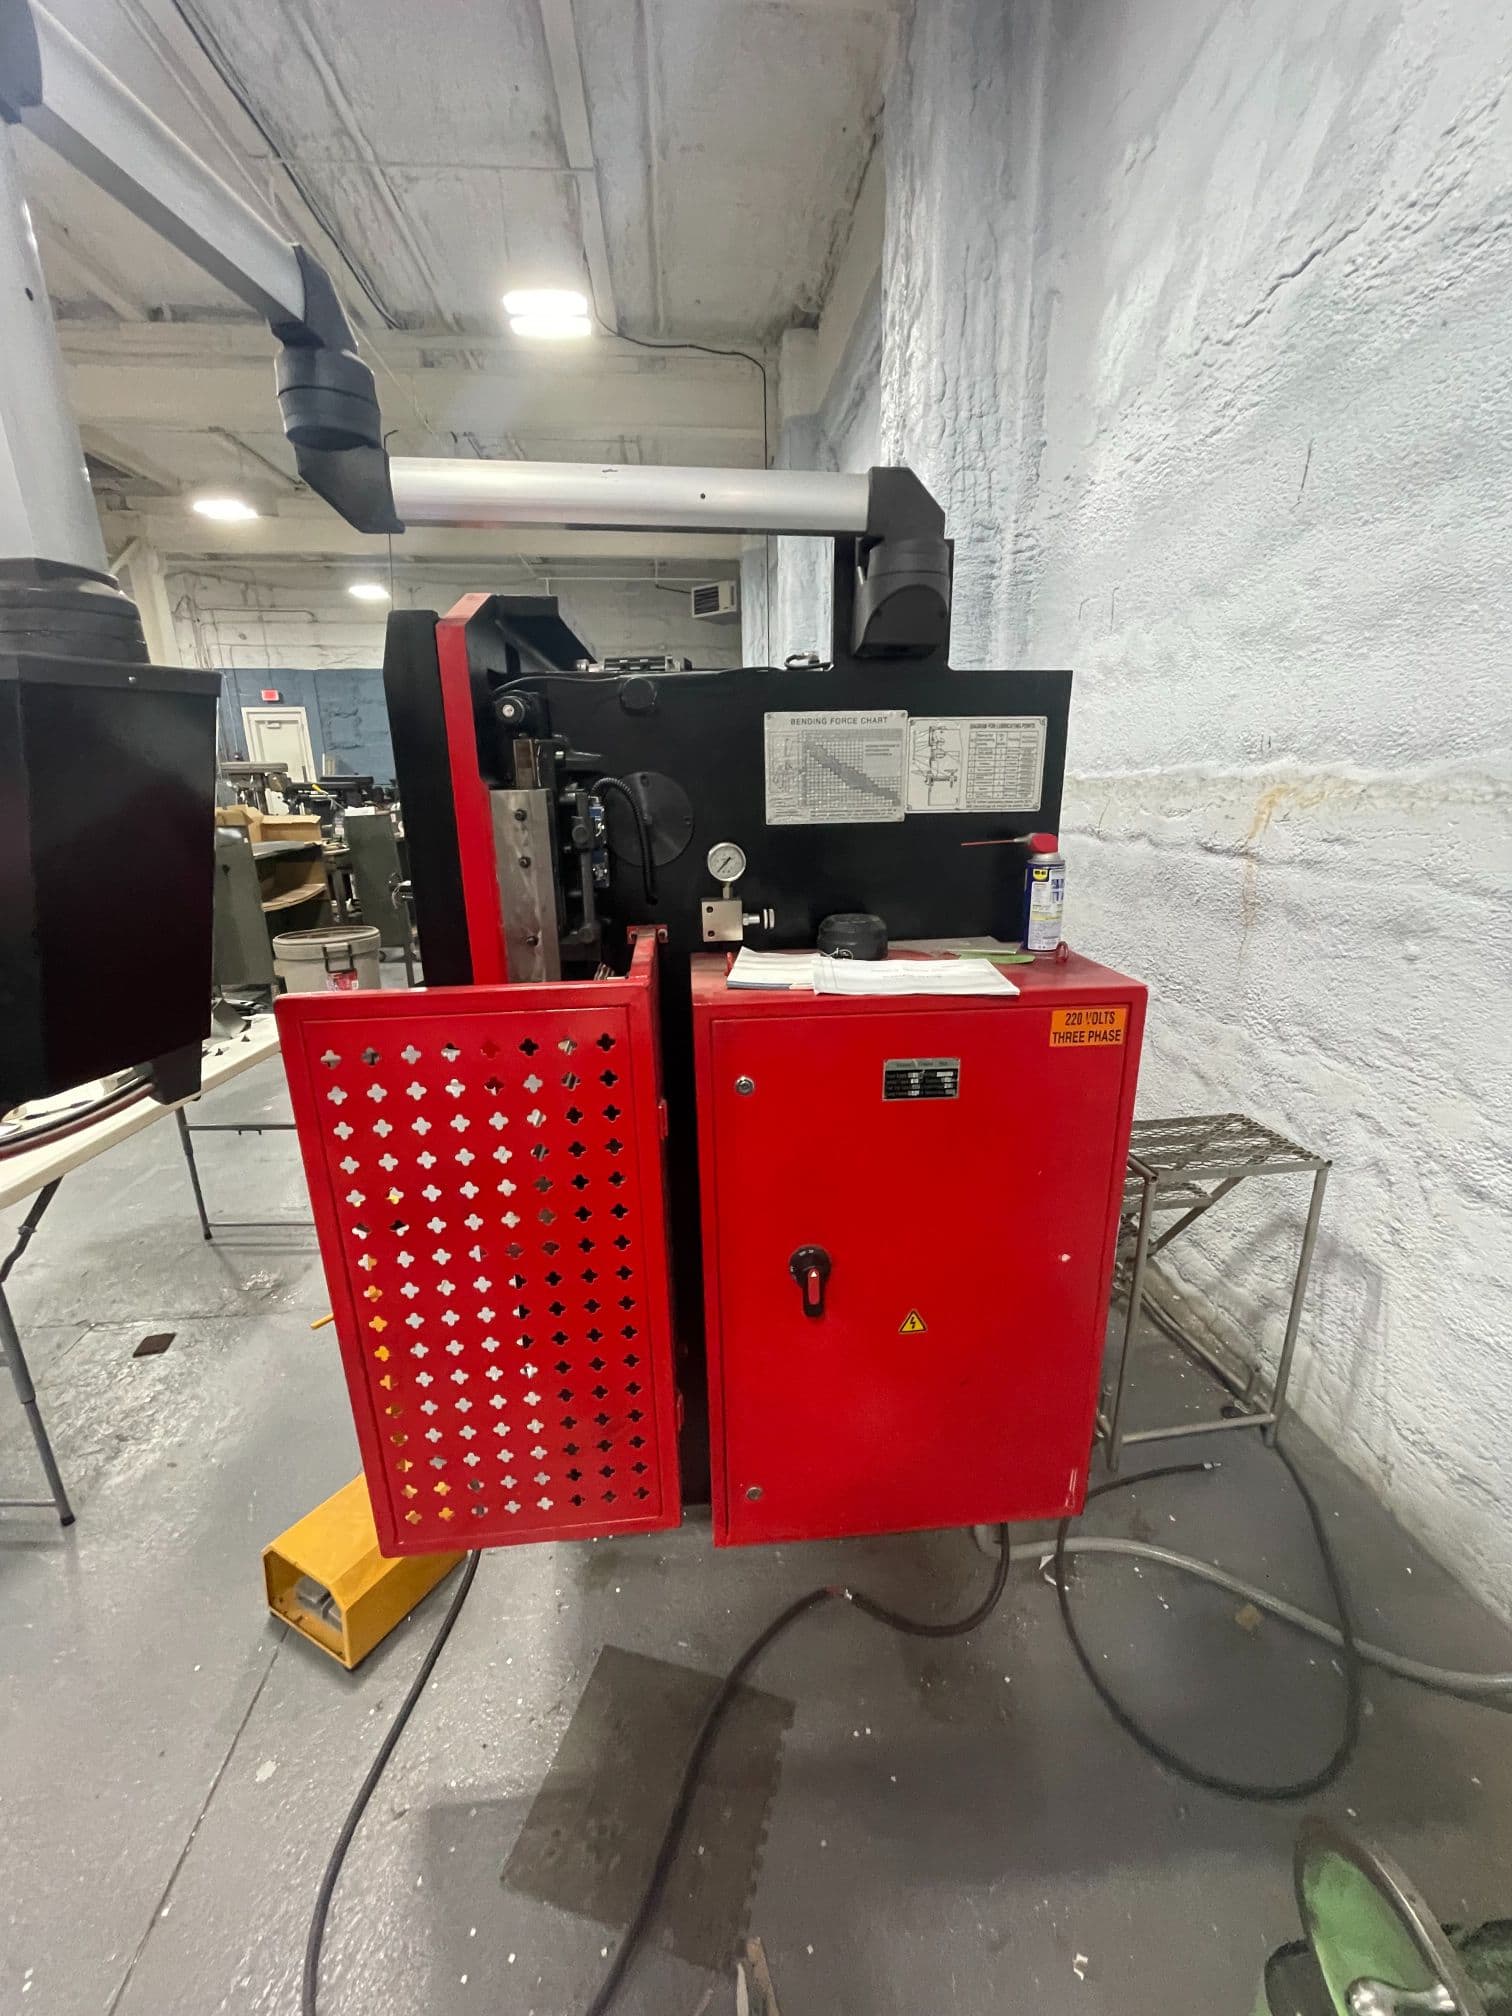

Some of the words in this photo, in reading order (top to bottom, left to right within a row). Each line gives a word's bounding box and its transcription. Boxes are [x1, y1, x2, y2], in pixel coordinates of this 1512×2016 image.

[829, 717, 858, 725] FORCE
[860, 716, 887, 724] CHART
[1065, 1012, 1083, 1026] 220
[1086, 1011, 1115, 1025] VOLTS
[1052, 1030, 1085, 1044] THREE
[1088, 1029, 1121, 1042] PHASE
